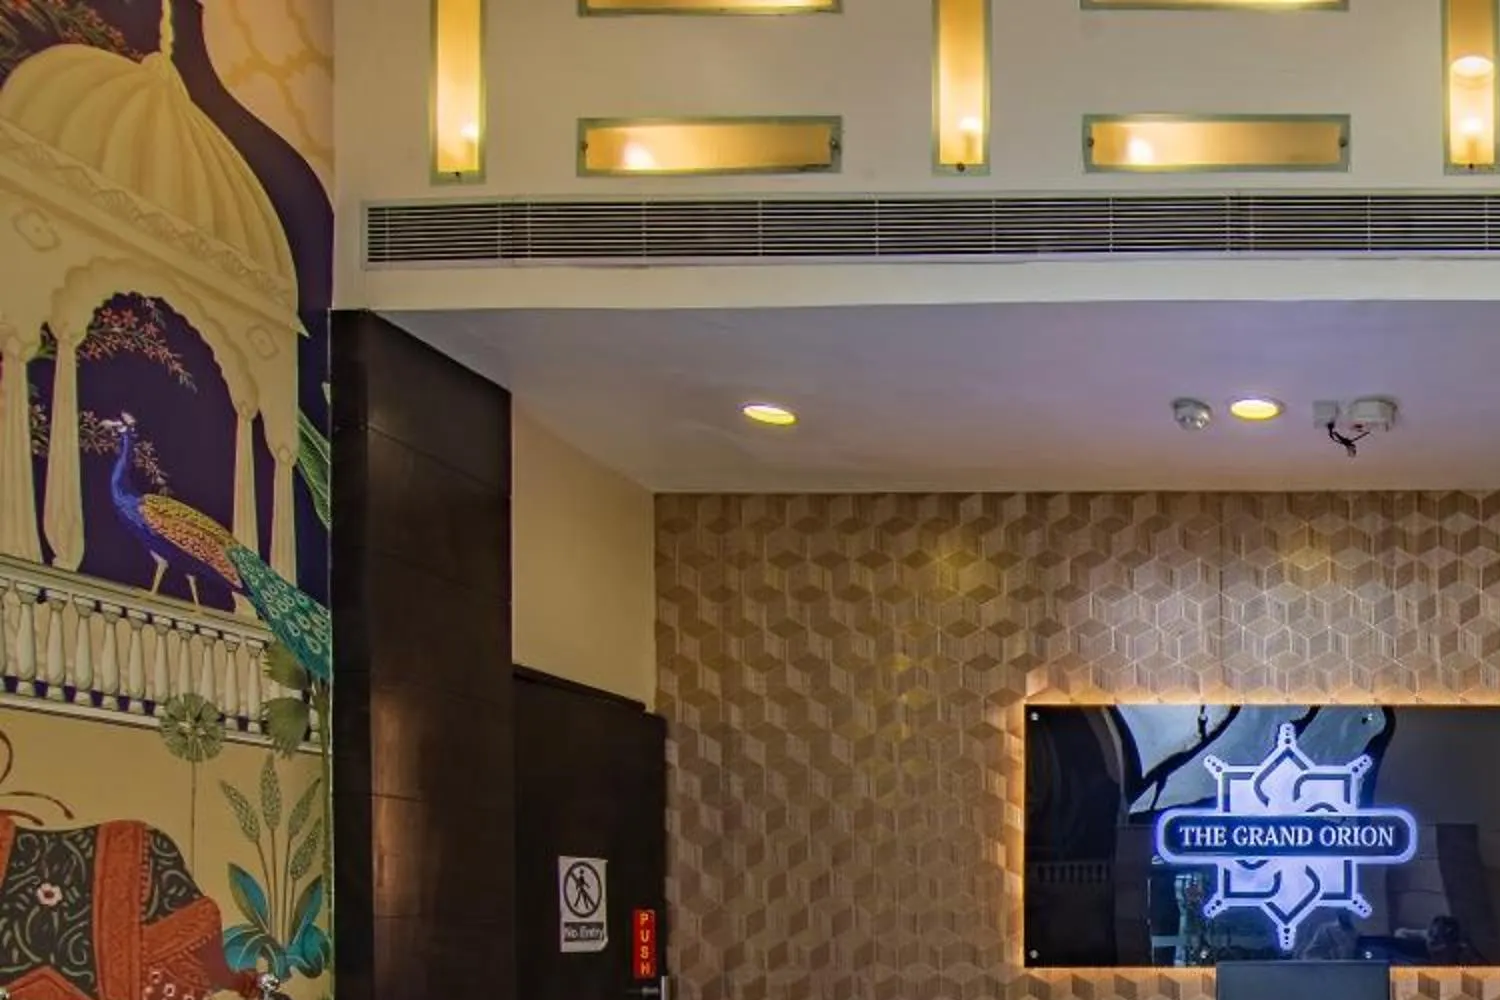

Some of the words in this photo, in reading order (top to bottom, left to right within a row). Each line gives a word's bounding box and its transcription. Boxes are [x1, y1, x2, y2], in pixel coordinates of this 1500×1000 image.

[1180, 826, 1227, 847] THE
[1232, 826, 1313, 847] GRAND
[1319, 826, 1395, 847] ORION
[639, 911, 651, 976] PUSH
